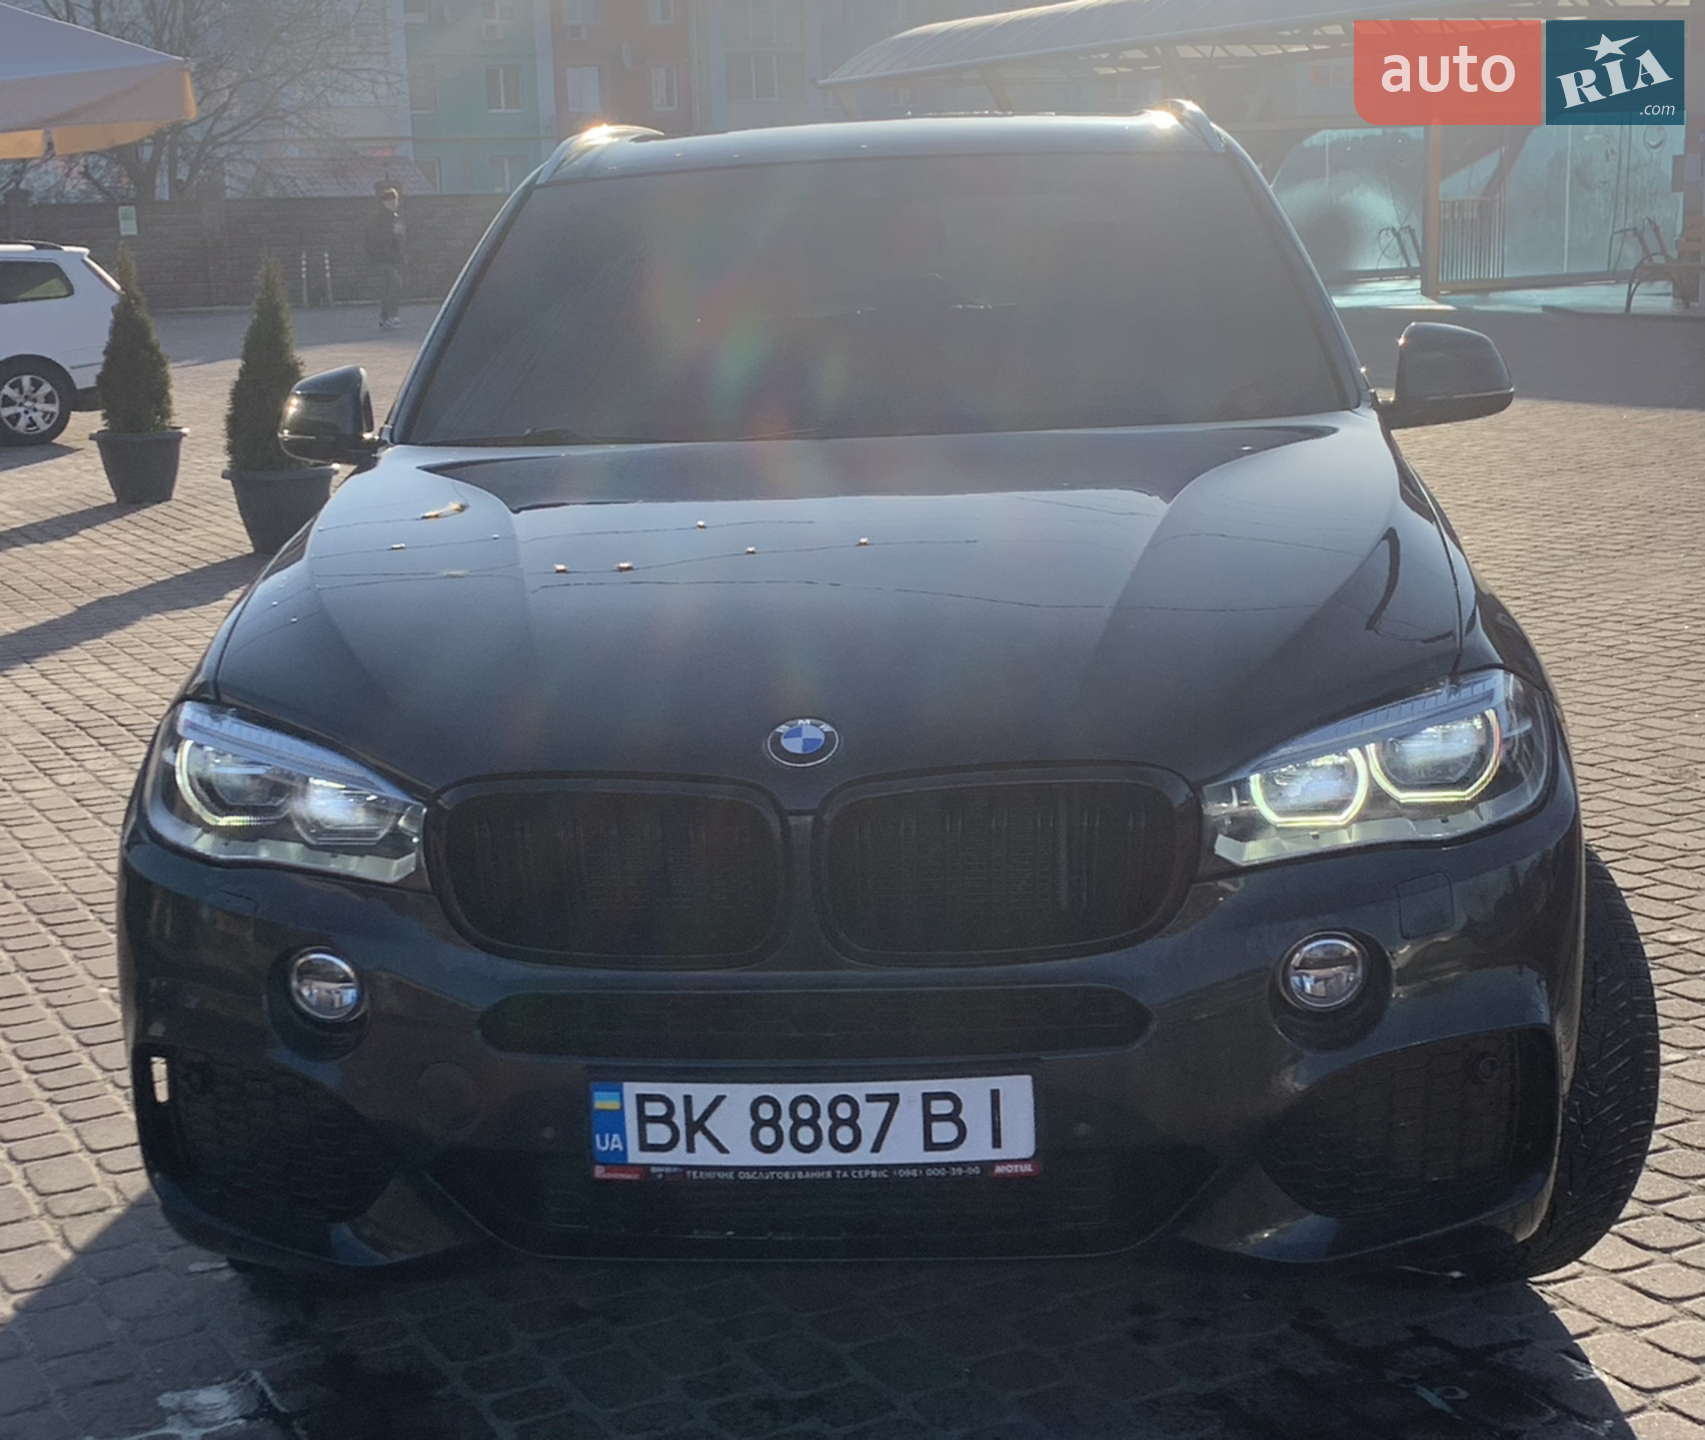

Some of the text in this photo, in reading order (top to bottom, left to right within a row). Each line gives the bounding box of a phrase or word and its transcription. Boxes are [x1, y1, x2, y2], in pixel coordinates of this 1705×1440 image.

[636, 1093, 730, 1154] BK
[749, 1094, 900, 1154] 8887
[595, 1133, 624, 1152] UA
[994, 1163, 1033, 1174] MOTUL
